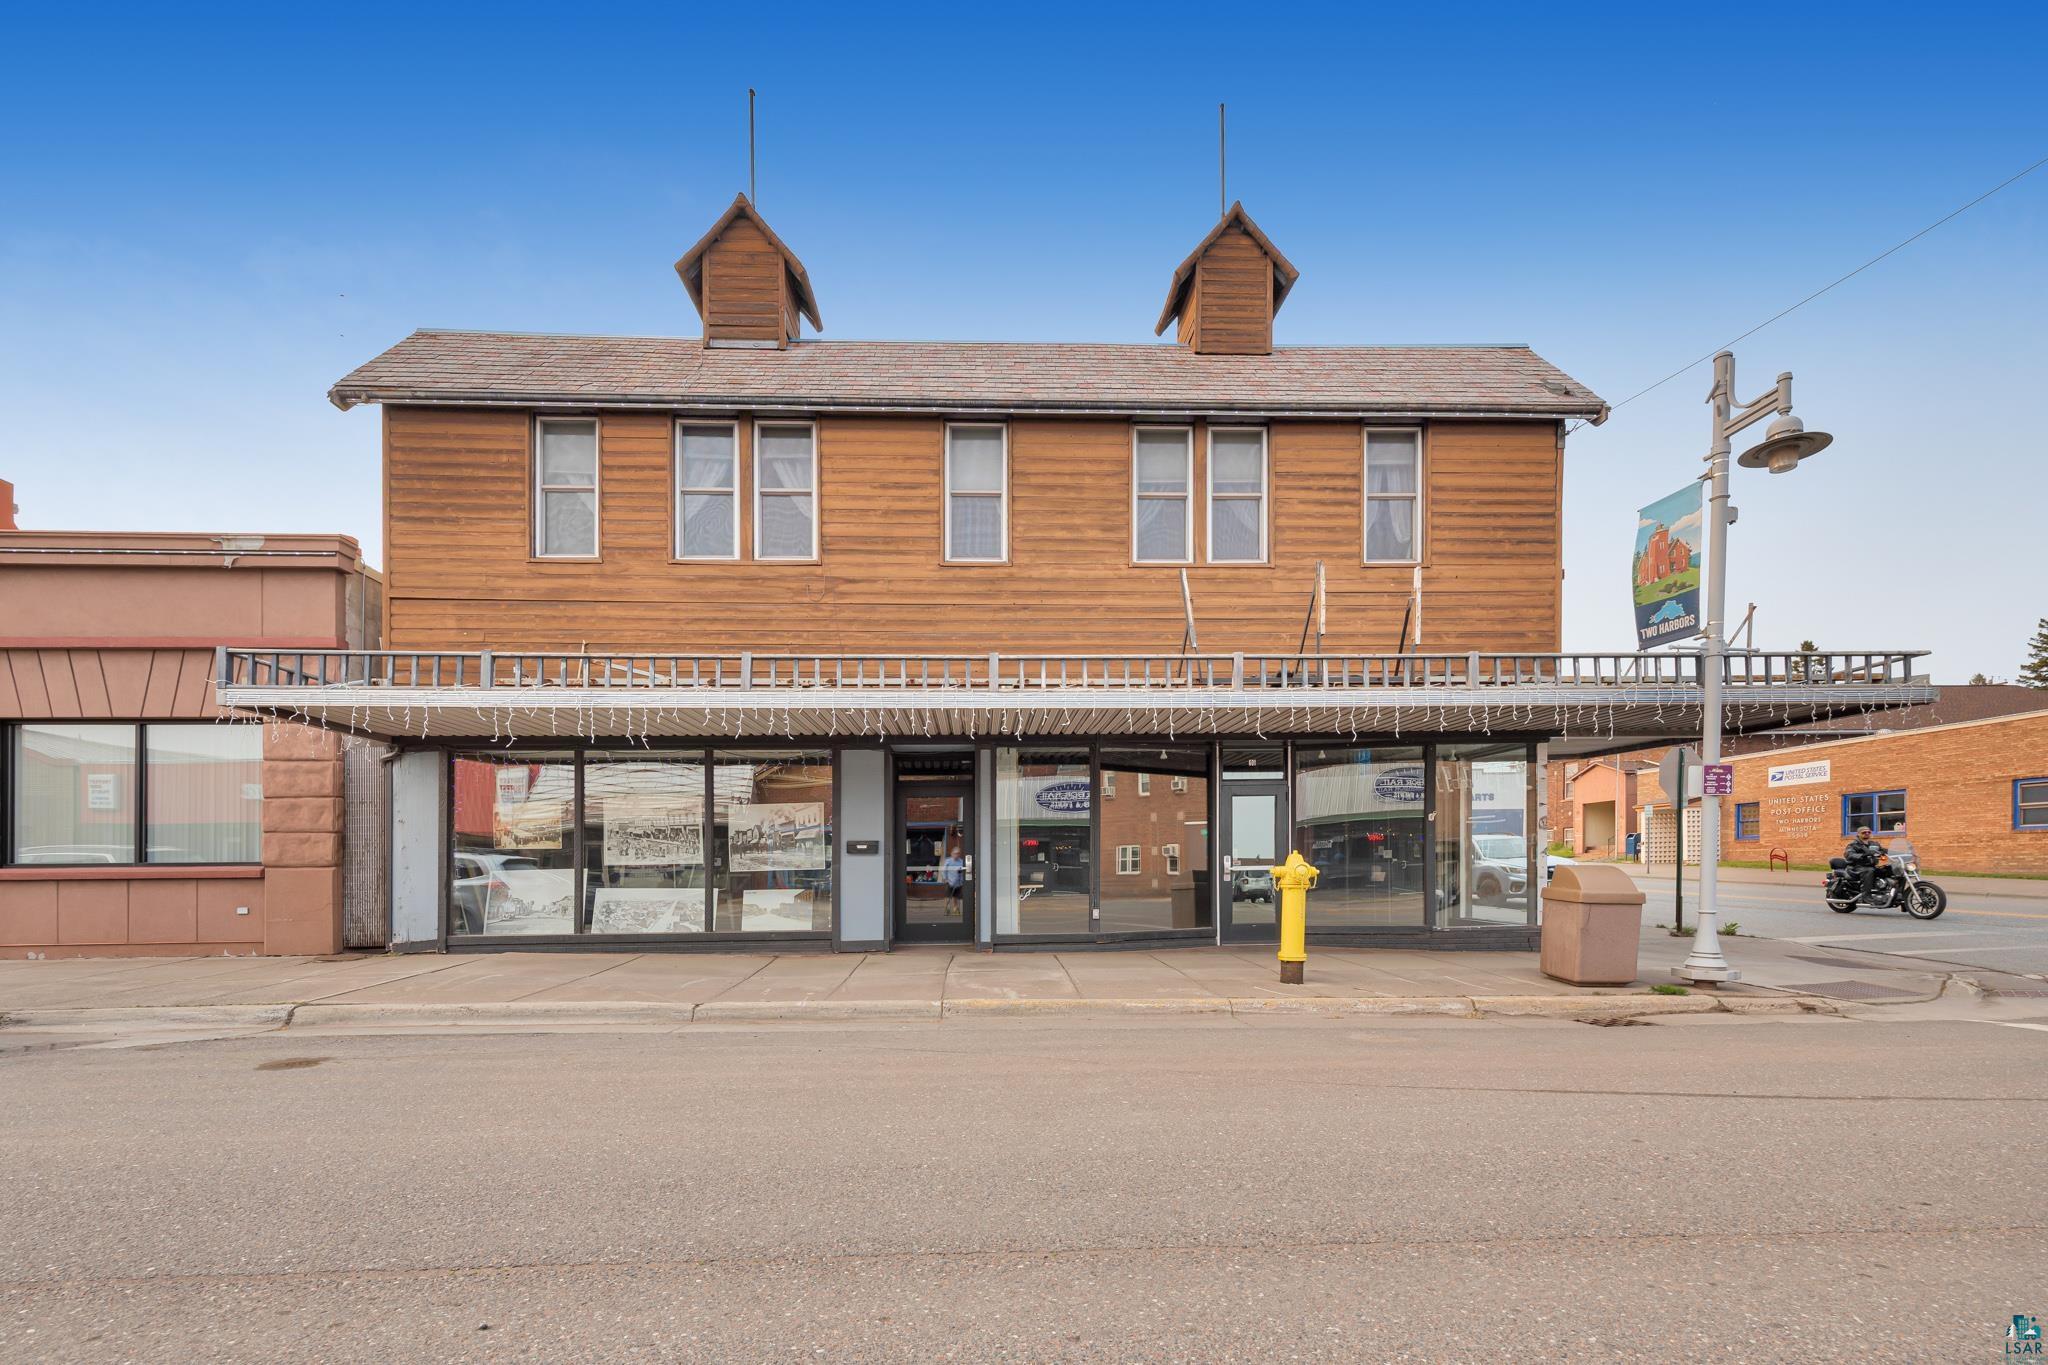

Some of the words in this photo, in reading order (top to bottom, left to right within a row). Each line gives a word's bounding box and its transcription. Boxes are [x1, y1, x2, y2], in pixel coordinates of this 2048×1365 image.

[1640, 625, 1658, 639] TWO
[1659, 614, 1695, 634] HARBORS
[1768, 797, 1797, 805] UNITED
[1800, 794, 1829, 803] STATES
[1770, 808, 1791, 816] POST
[1795, 806, 1826, 814] OFFICE
